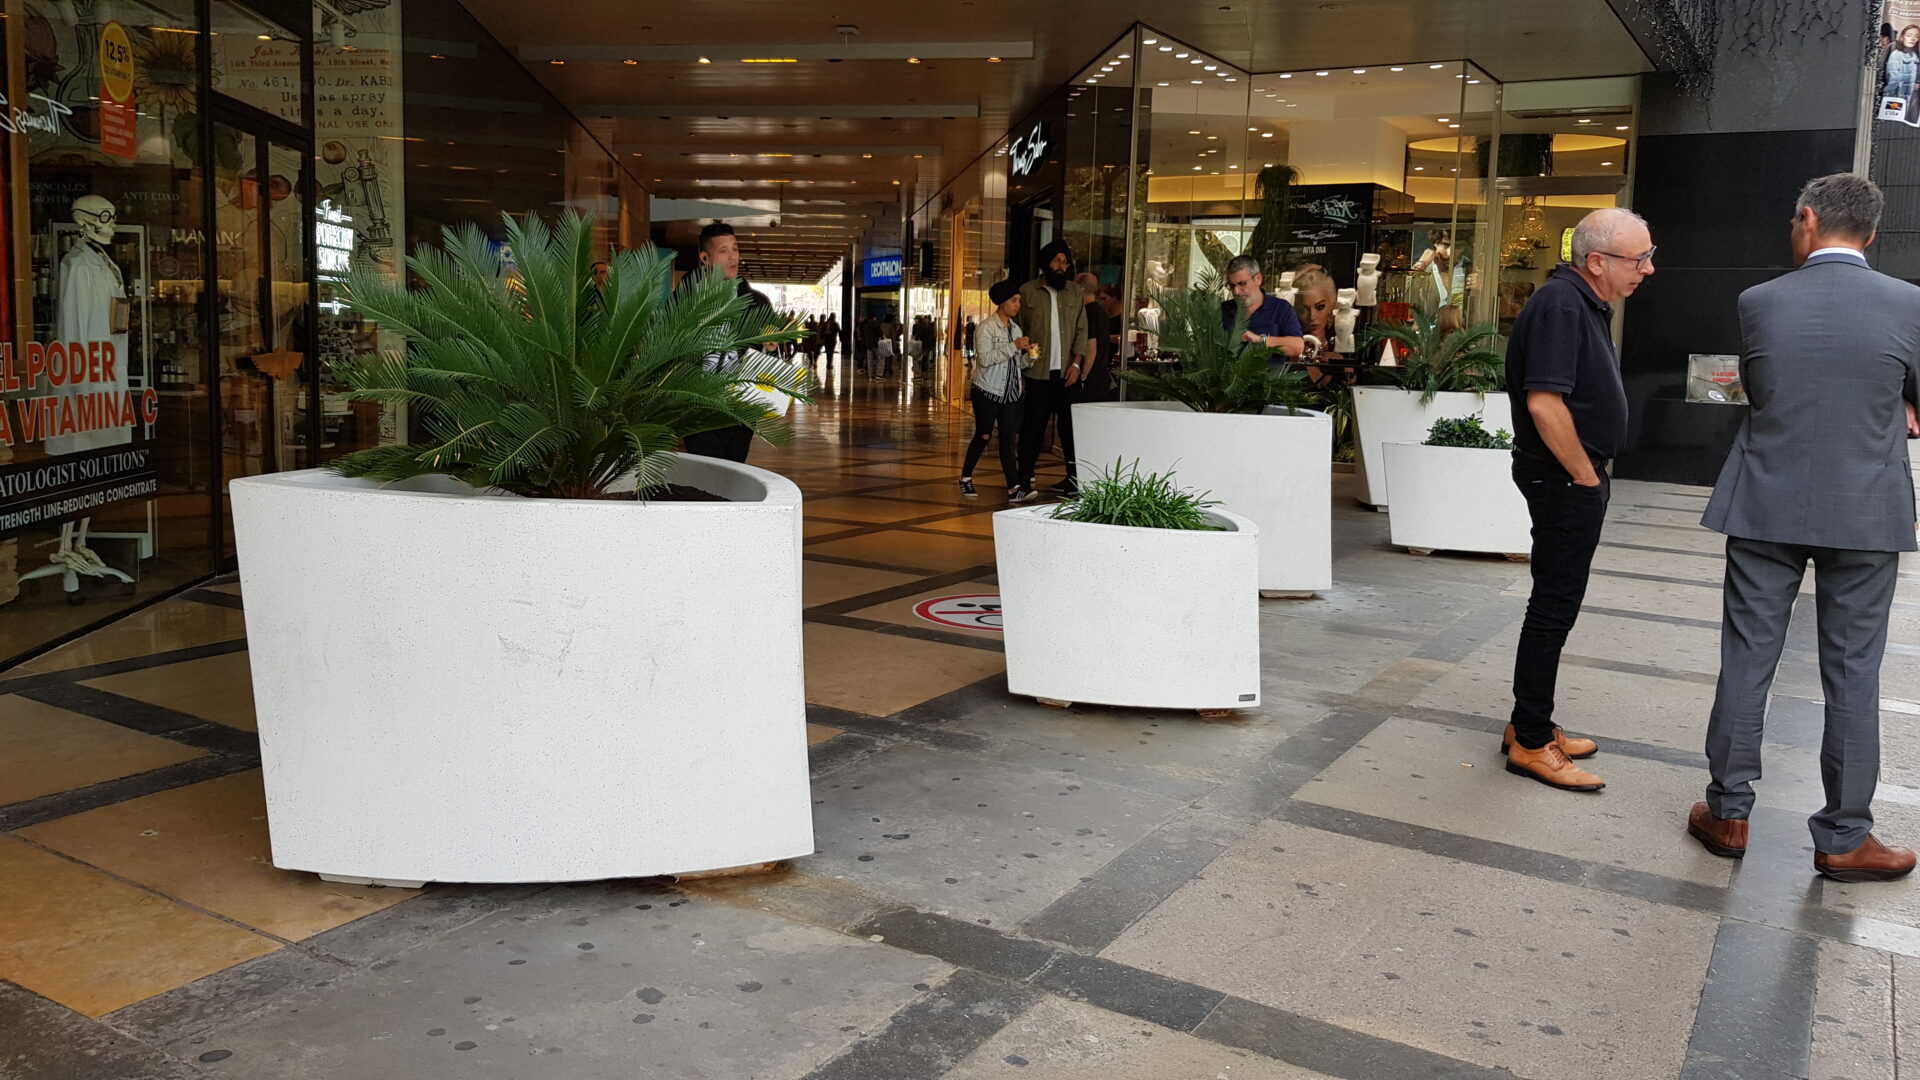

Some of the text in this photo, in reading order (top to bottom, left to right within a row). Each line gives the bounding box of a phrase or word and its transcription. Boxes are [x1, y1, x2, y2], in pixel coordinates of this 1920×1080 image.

[104, 39, 130, 64] 12,5%
[335, 77, 354, 87] Dr.
[341, 93, 386, 104] spray
[333, 107, 345, 116] a
[351, 105, 385, 118] day.
[346, 120, 370, 129] USE
[1302, 246, 1327, 254] RITA ORA
[870, 259, 902, 278] DECATHLON
[26, 340, 117, 391] PODER
[17, 390, 137, 444] VITAMINA
[141, 386, 159, 425] C
[43, 490, 105, 520] LINE-REDUCING
[106, 478, 157, 503] CONCENTRATE
